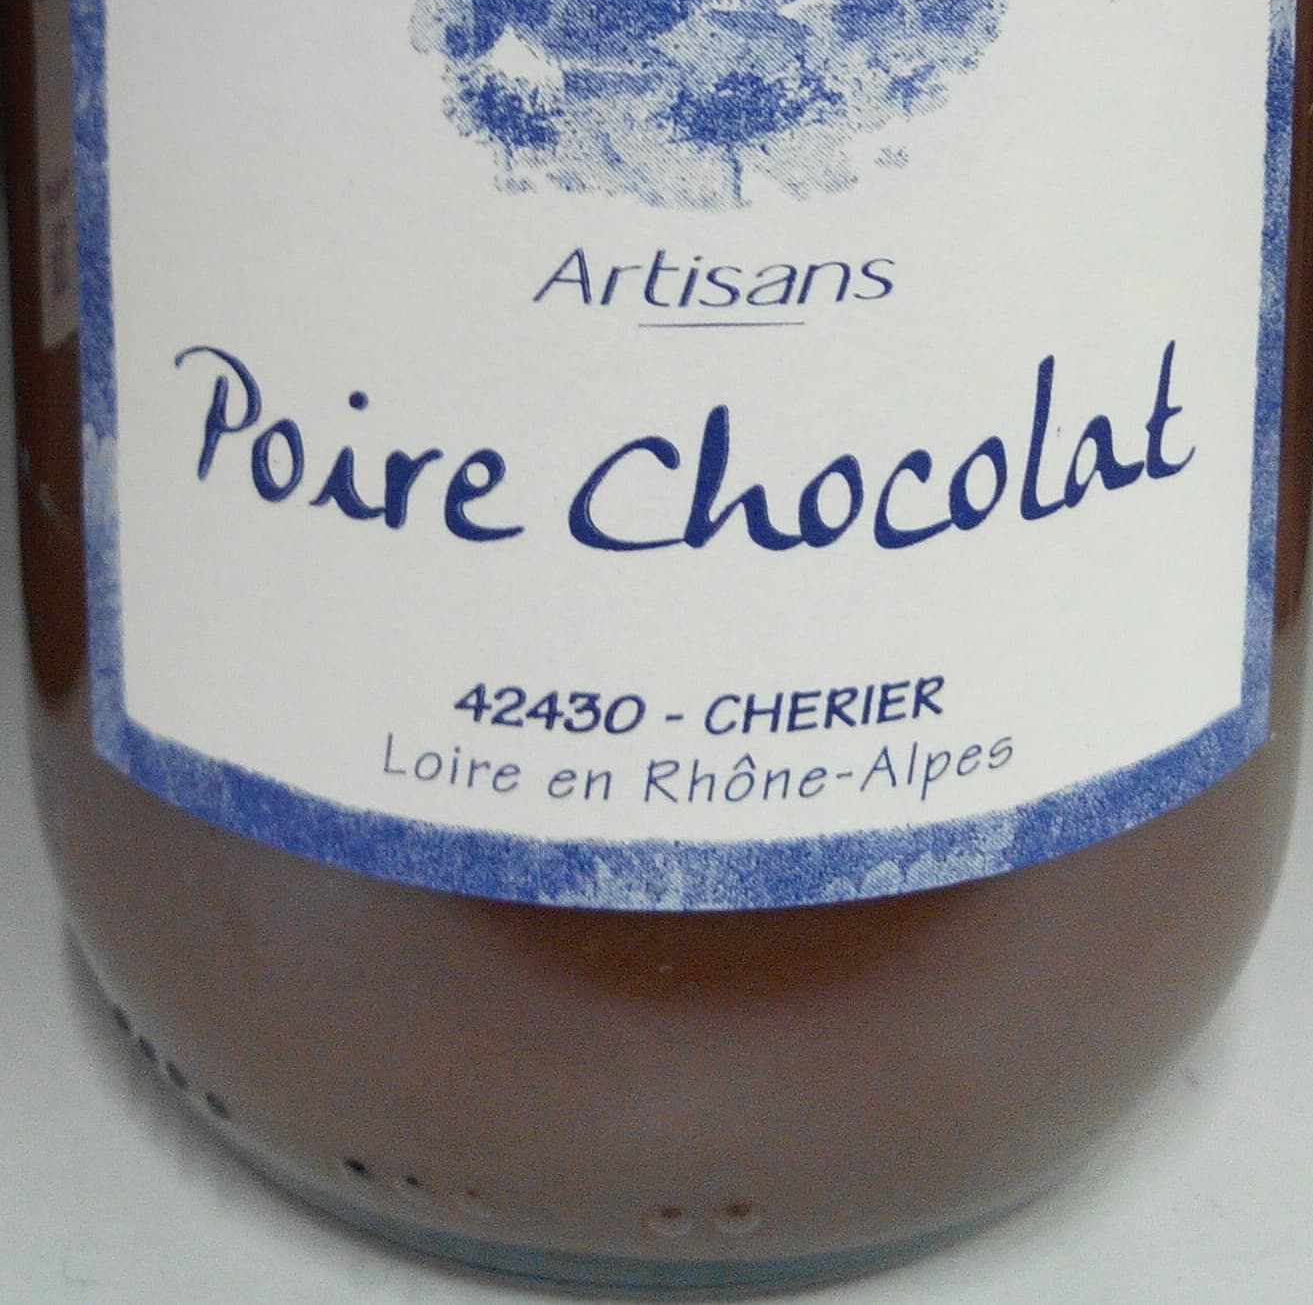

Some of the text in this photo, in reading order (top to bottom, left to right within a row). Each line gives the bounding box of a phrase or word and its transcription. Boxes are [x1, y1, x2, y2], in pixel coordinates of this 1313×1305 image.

[532, 248, 895, 308] Artisans
[174, 340, 1196, 552] Poire Chocolat
[454, 683, 646, 735] 42430
[704, 675, 944, 736] CHERIER
[383, 733, 1014, 803] Loire en Rhône-Alpes
